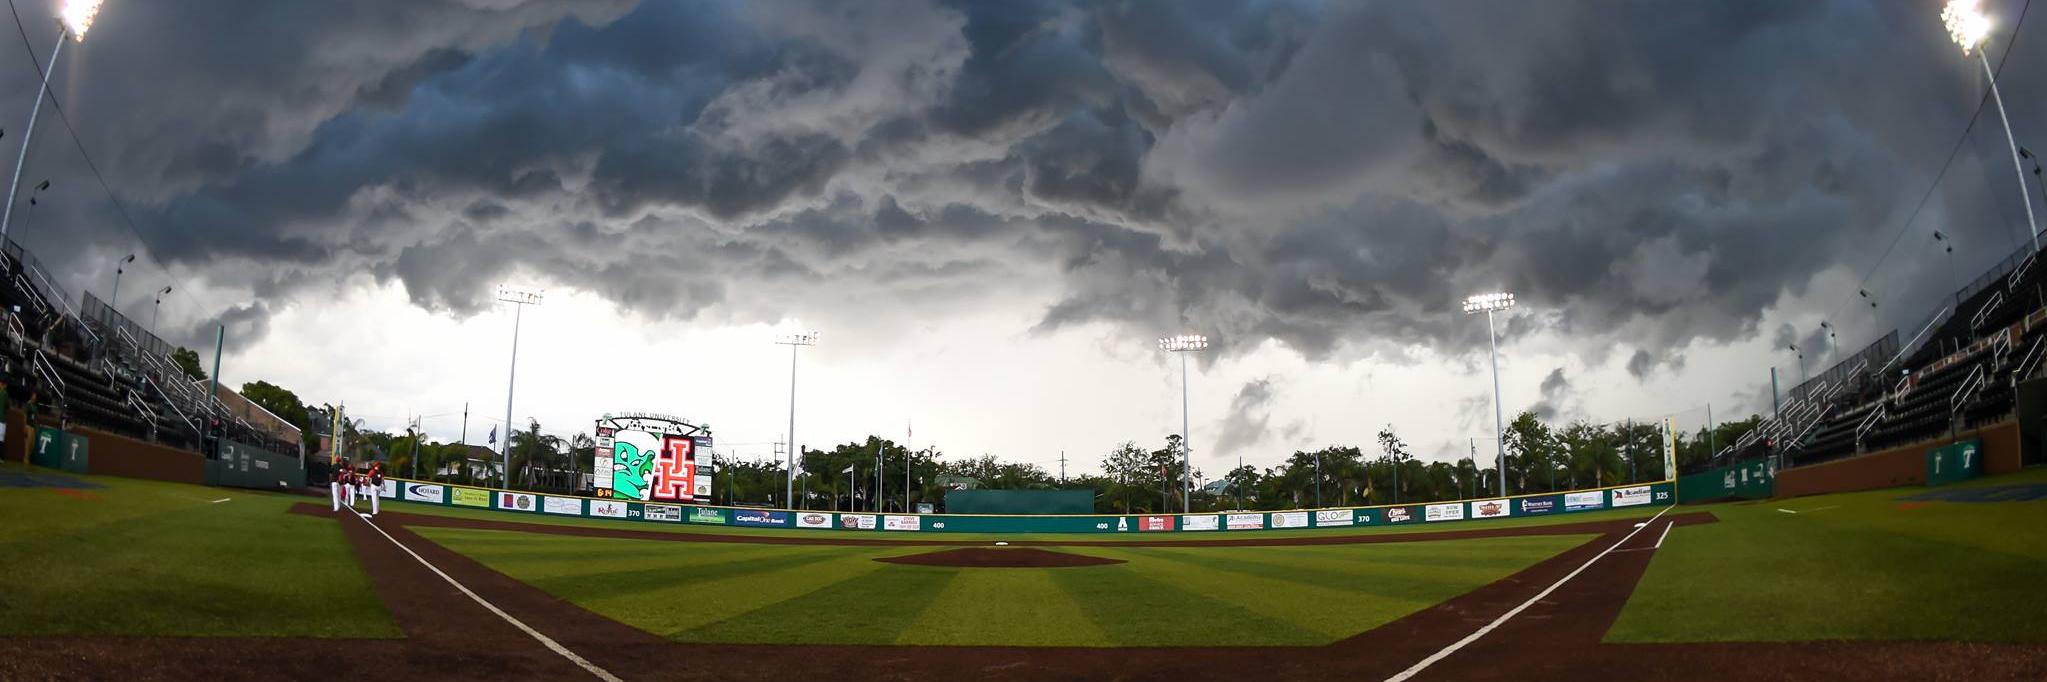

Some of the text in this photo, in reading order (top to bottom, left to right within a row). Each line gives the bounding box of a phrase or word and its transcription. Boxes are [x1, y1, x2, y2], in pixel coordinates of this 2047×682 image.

[620, 411, 690, 425] TULANE UNIVERSITY
[1656, 491, 1669, 500] 325
[628, 509, 640, 517] 370
[697, 507, 718, 517] Tulane
[1358, 515, 1370, 523] 370
